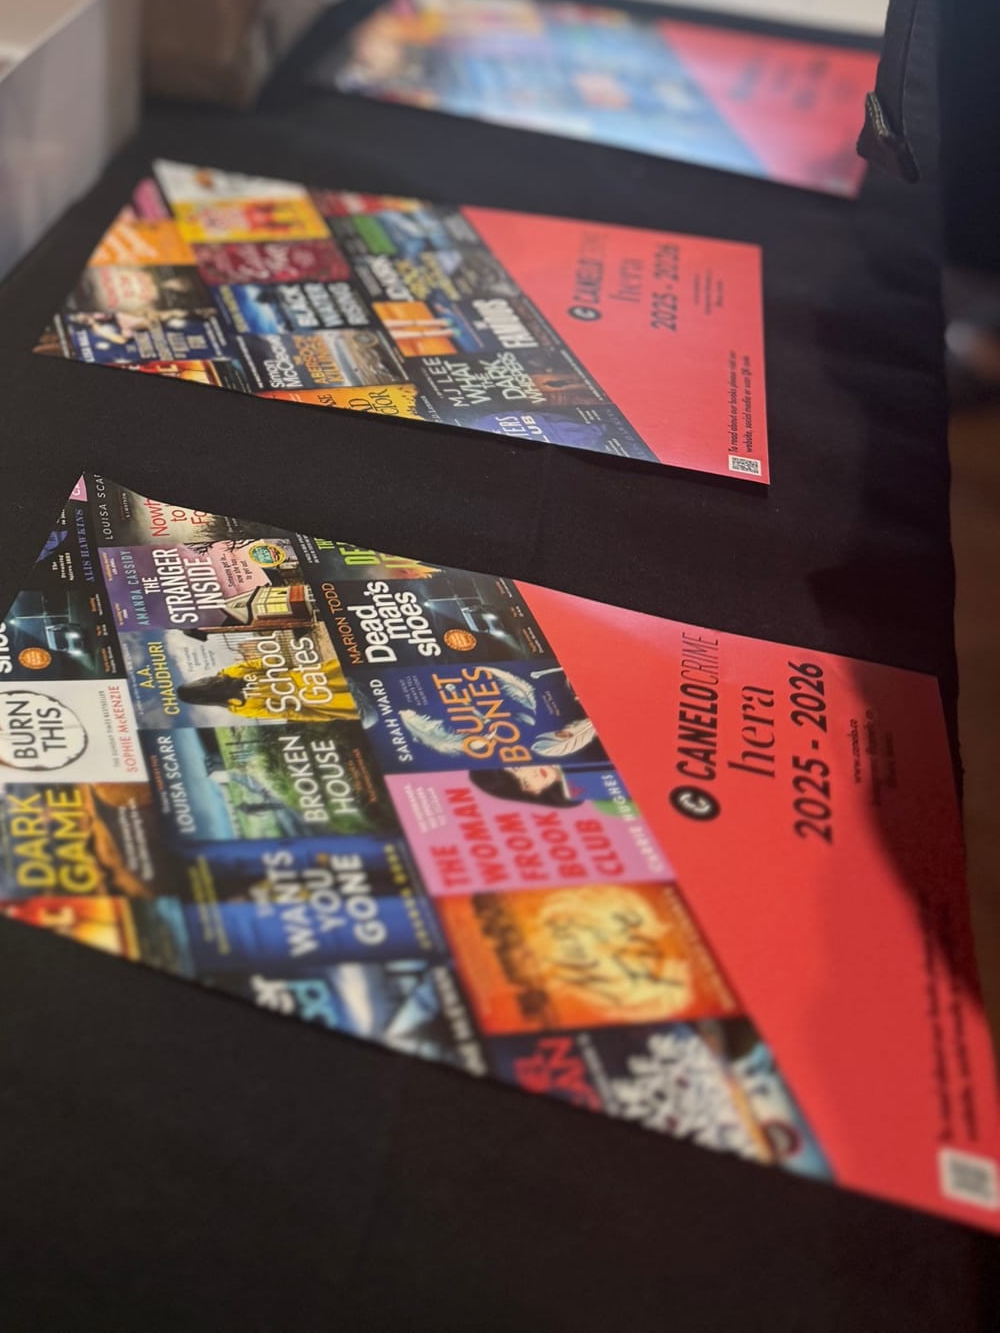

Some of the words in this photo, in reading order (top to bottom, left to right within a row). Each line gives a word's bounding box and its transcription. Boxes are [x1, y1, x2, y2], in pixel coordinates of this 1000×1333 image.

[651, 292, 678, 332] 2025
[264, 360, 285, 388] Simon
[423, 357, 453, 383] LEE
[444, 361, 492, 405] WHAT
[475, 372, 495, 390] THE
[479, 359, 527, 400] DARK
[497, 351, 547, 404] WHISPERS
[369, 389, 399, 415] CTOR
[443, 388, 469, 407] MJ
[728, 388, 737, 404] books
[521, 415, 550, 443] LUB
[728, 415, 737, 431] about
[728, 432, 737, 445] read
[742, 413, 752, 429] social
[75, 508, 91, 559] HAWKINS
[99, 503, 114, 541] LOUISA
[143, 498, 170, 537] Nowh
[170, 509, 187, 522] to
[82, 558, 96, 583] ALIS
[121, 550, 139, 585] CASSIDY
[142, 577, 161, 594] THE
[152, 549, 199, 624] STRANGER
[184, 557, 227, 610] INSIDE
[131, 588, 149, 626] AMANDA
[321, 582, 343, 614] TODD
[363, 581, 406, 639] man's
[335, 616, 361, 664] MARION
[347, 605, 397, 663] Dead
[394, 591, 441, 656] shoes
[140, 665, 156, 688] A.A.
[148, 642, 180, 715] CHAUDHURI
[243, 674, 257, 699] The
[257, 632, 300, 713] School
[290, 637, 333, 705] Gates
[98, 690, 109, 717] BESTSELLER
[108, 686, 129, 732] McKENZIE
[370, 679, 394, 714] WARD
[432, 674, 494, 758] QUIET
[462, 667, 532, 762] BONES
[788, 661, 827, 733] 2026
[6, 701, 38, 758] BURN
[36, 707, 67, 752] THIS
[385, 719, 413, 762] SARAH
[728, 685, 775, 779] hera
[119, 737, 138, 772] SOPHIE
[157, 735, 182, 780] SCARR
[311, 739, 358, 814] HOUSE
[278, 735, 329, 823] BROKEN
[601, 774, 637, 821] HUGHES
[792, 756, 833, 846] 2025
[170, 785, 196, 834] LOUISA
[7, 793, 56, 888] DARK
[47, 789, 99, 893] GAME
[444, 787, 507, 886] WOMAN
[494, 812, 547, 881] FROM
[531, 810, 588, 878] BOOK
[574, 819, 625, 876] CLUB
[430, 844, 471, 887] THE
[262, 850, 319, 957] WANTS
[301, 868, 347, 933] YOU
[331, 854, 388, 946] GONE
